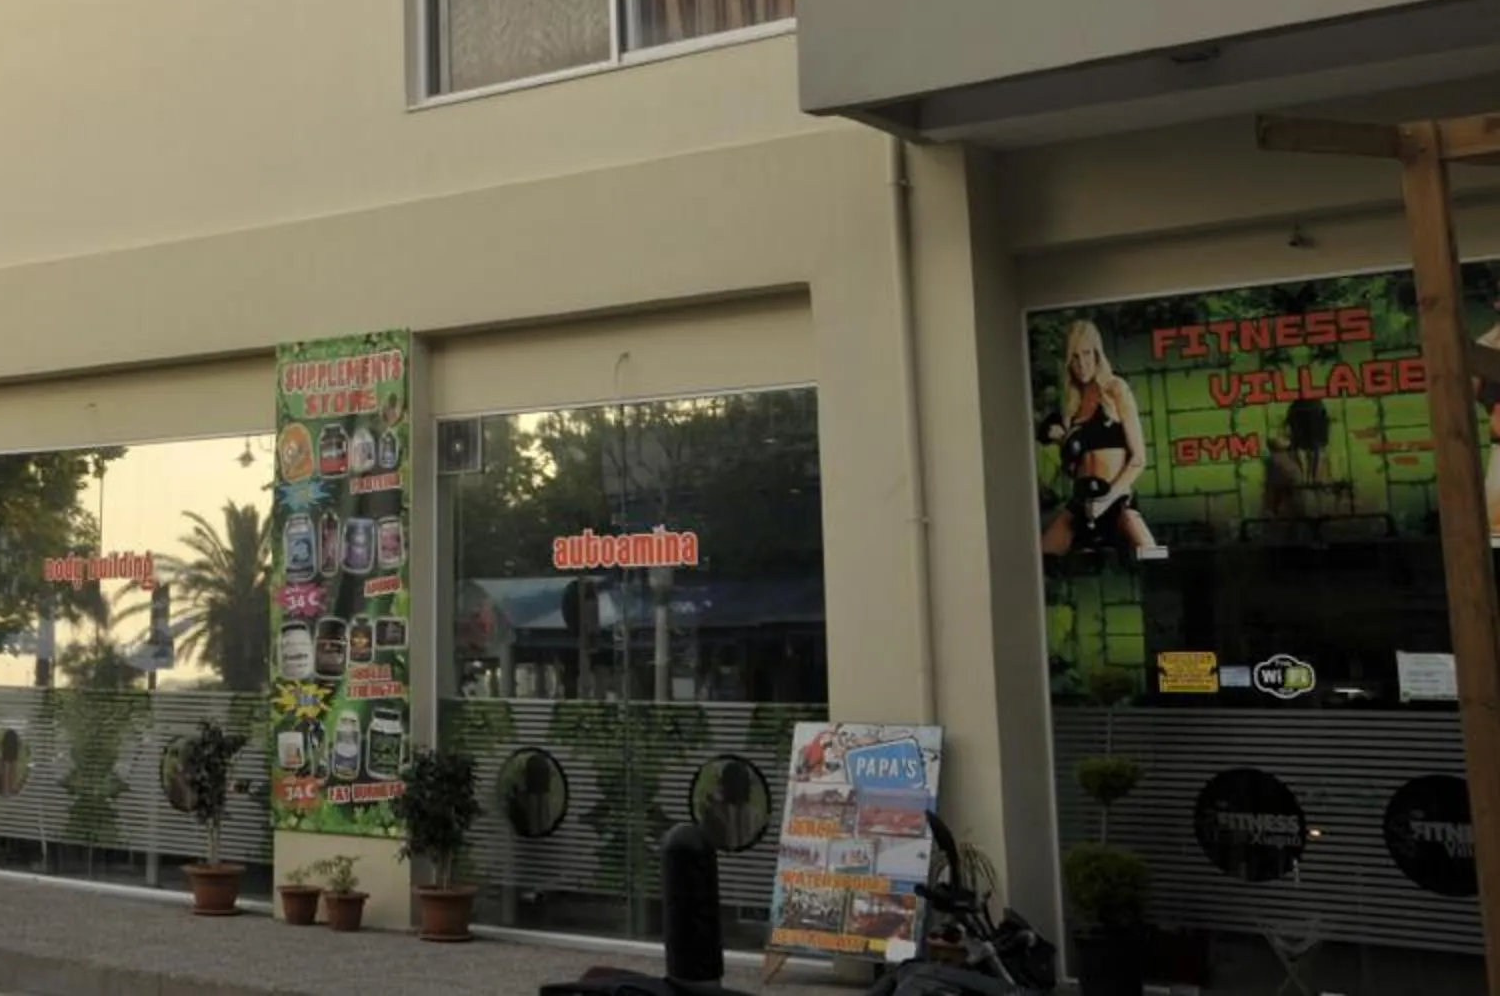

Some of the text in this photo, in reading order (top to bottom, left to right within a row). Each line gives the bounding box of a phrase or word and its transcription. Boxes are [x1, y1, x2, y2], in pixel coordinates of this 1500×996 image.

[1153, 307, 1375, 360] FITNESS
[284, 351, 403, 393] SUPPLEMENTS
[1209, 358, 1429, 409] VILLAGE
[305, 389, 377, 416] STORE
[1173, 433, 1260, 465] GYM
[554, 524, 698, 569] autoamina
[856, 756, 918, 779] PAPA'S
[1218, 812, 1300, 833] FITNESS
